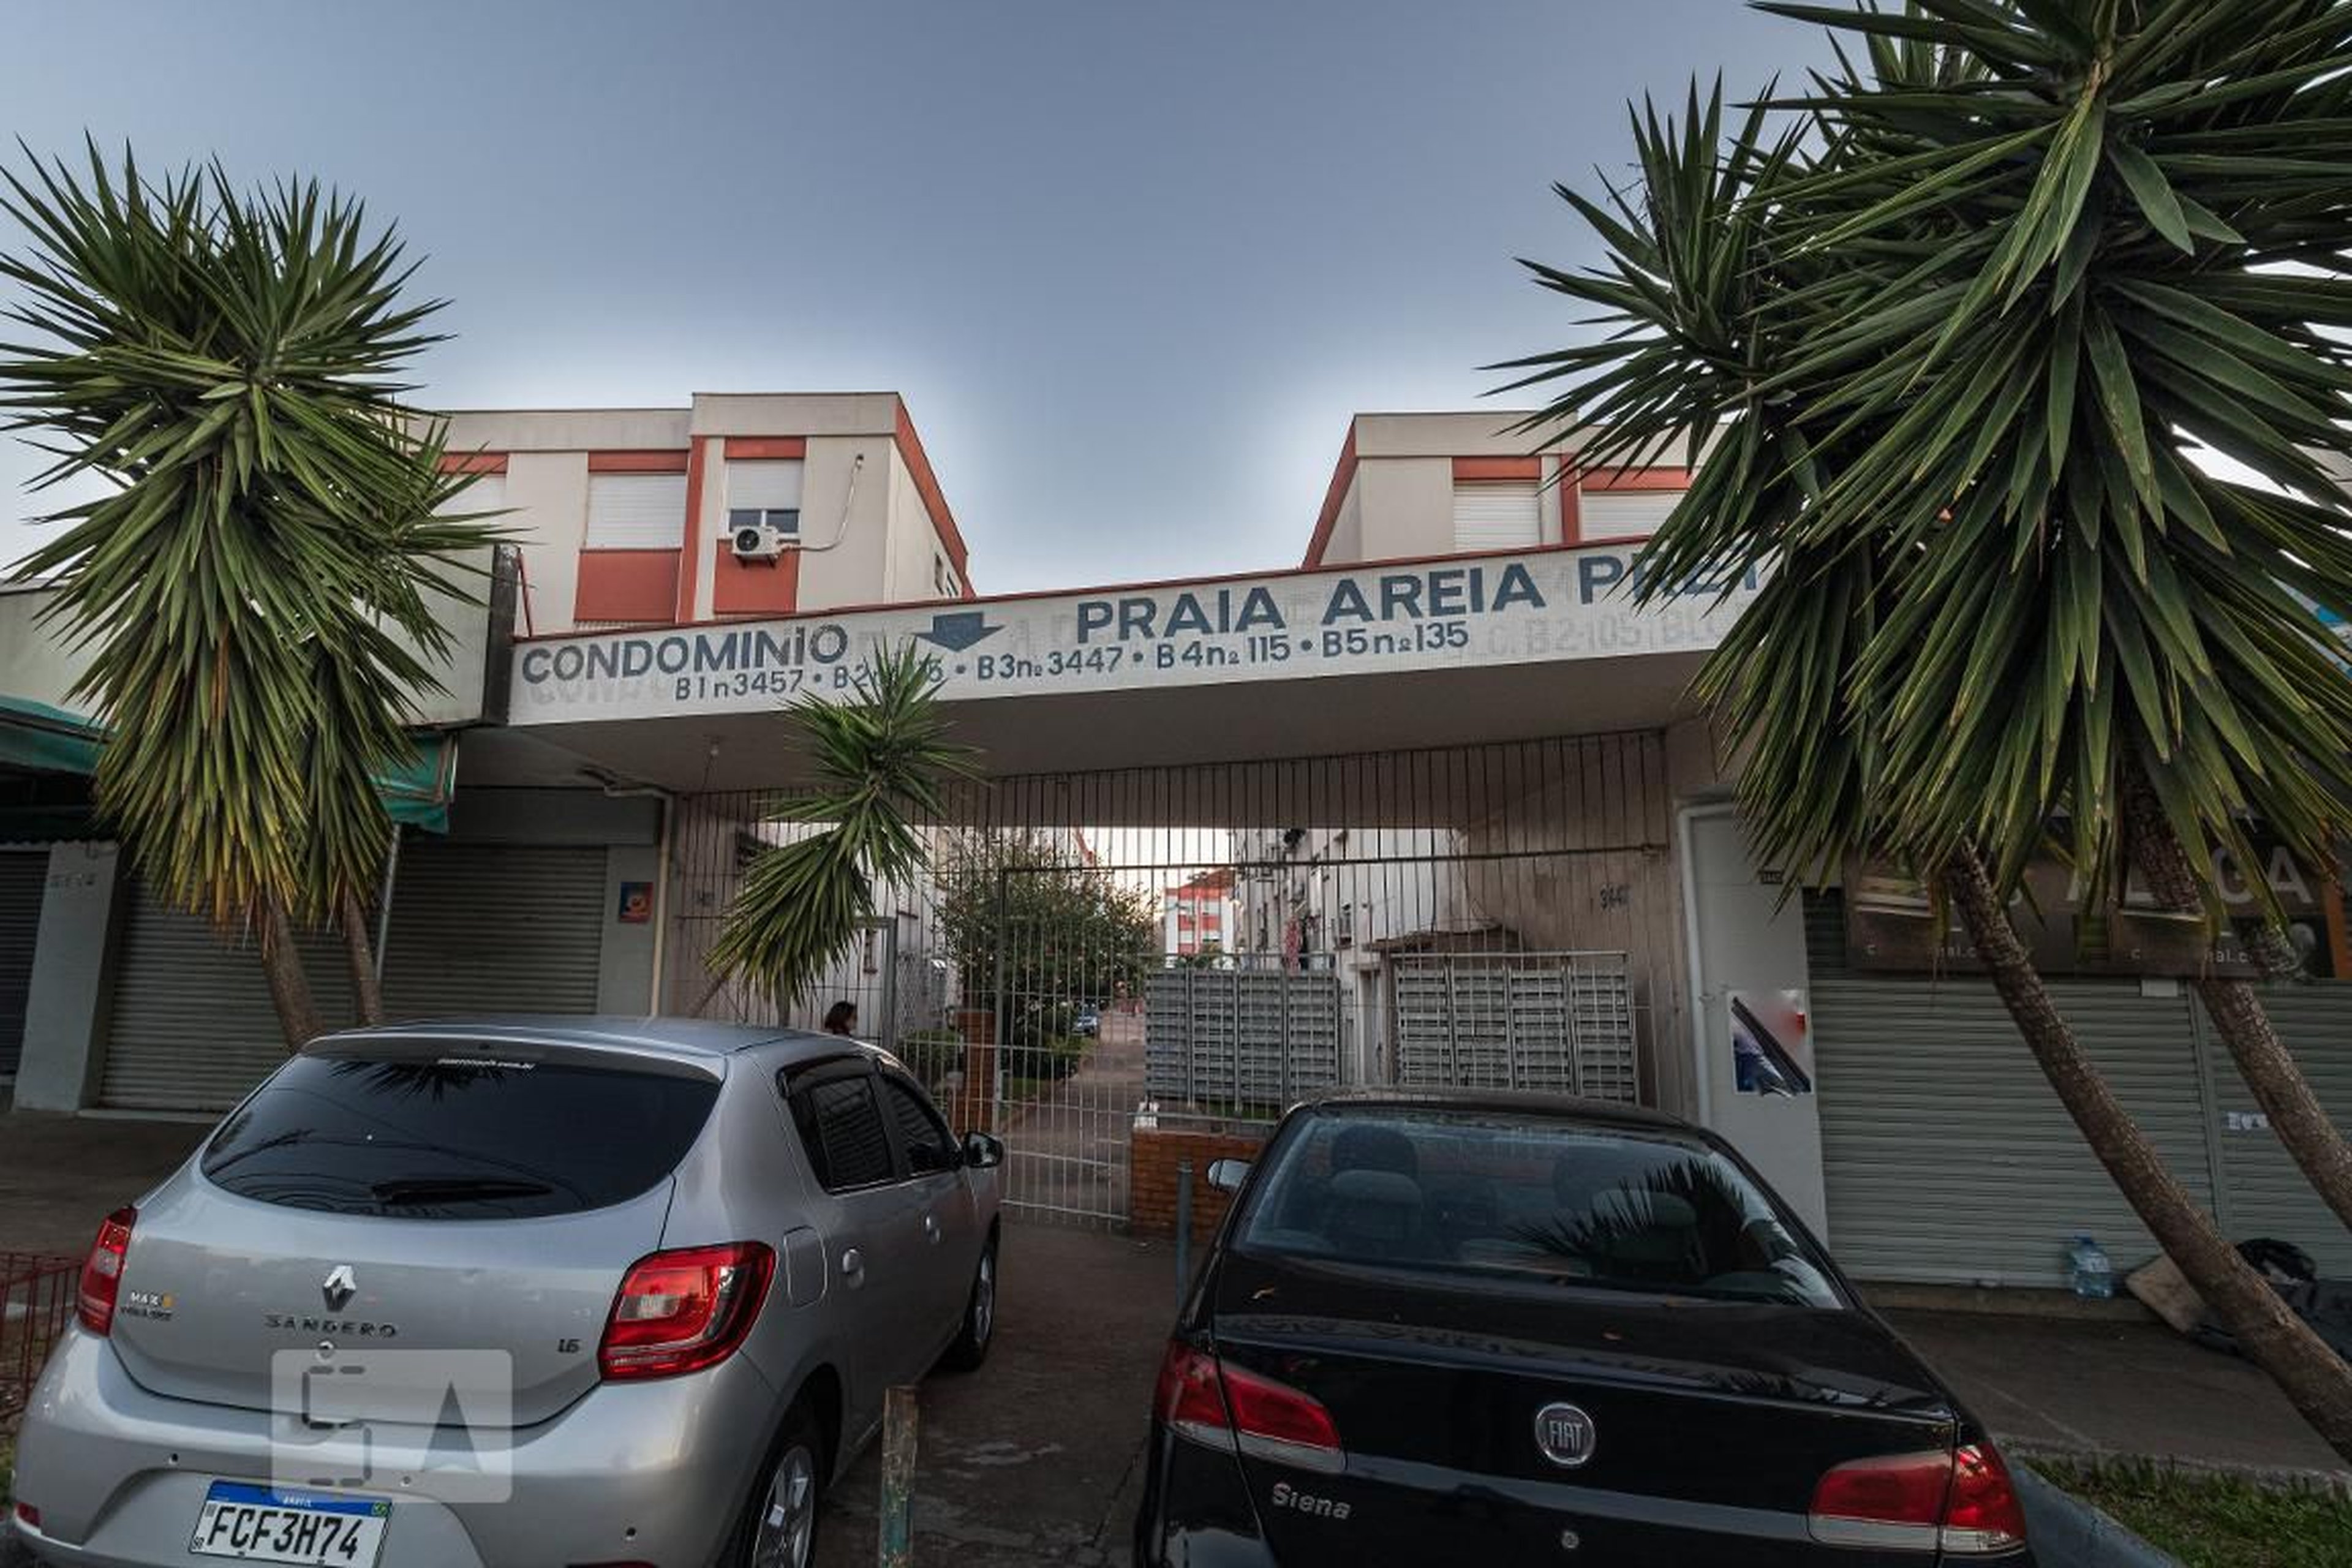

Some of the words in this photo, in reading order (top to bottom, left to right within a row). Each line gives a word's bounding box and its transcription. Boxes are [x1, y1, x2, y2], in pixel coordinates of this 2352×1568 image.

[1077, 587, 1286, 644] PRAIA
[1321, 562, 1547, 625] AREIA
[263, 1314, 397, 1338] SANDERO
[1549, 1420, 1583, 1453] FIAT
[1272, 1482, 1352, 1520] Siena
[205, 1505, 362, 1560] FCF3H74
